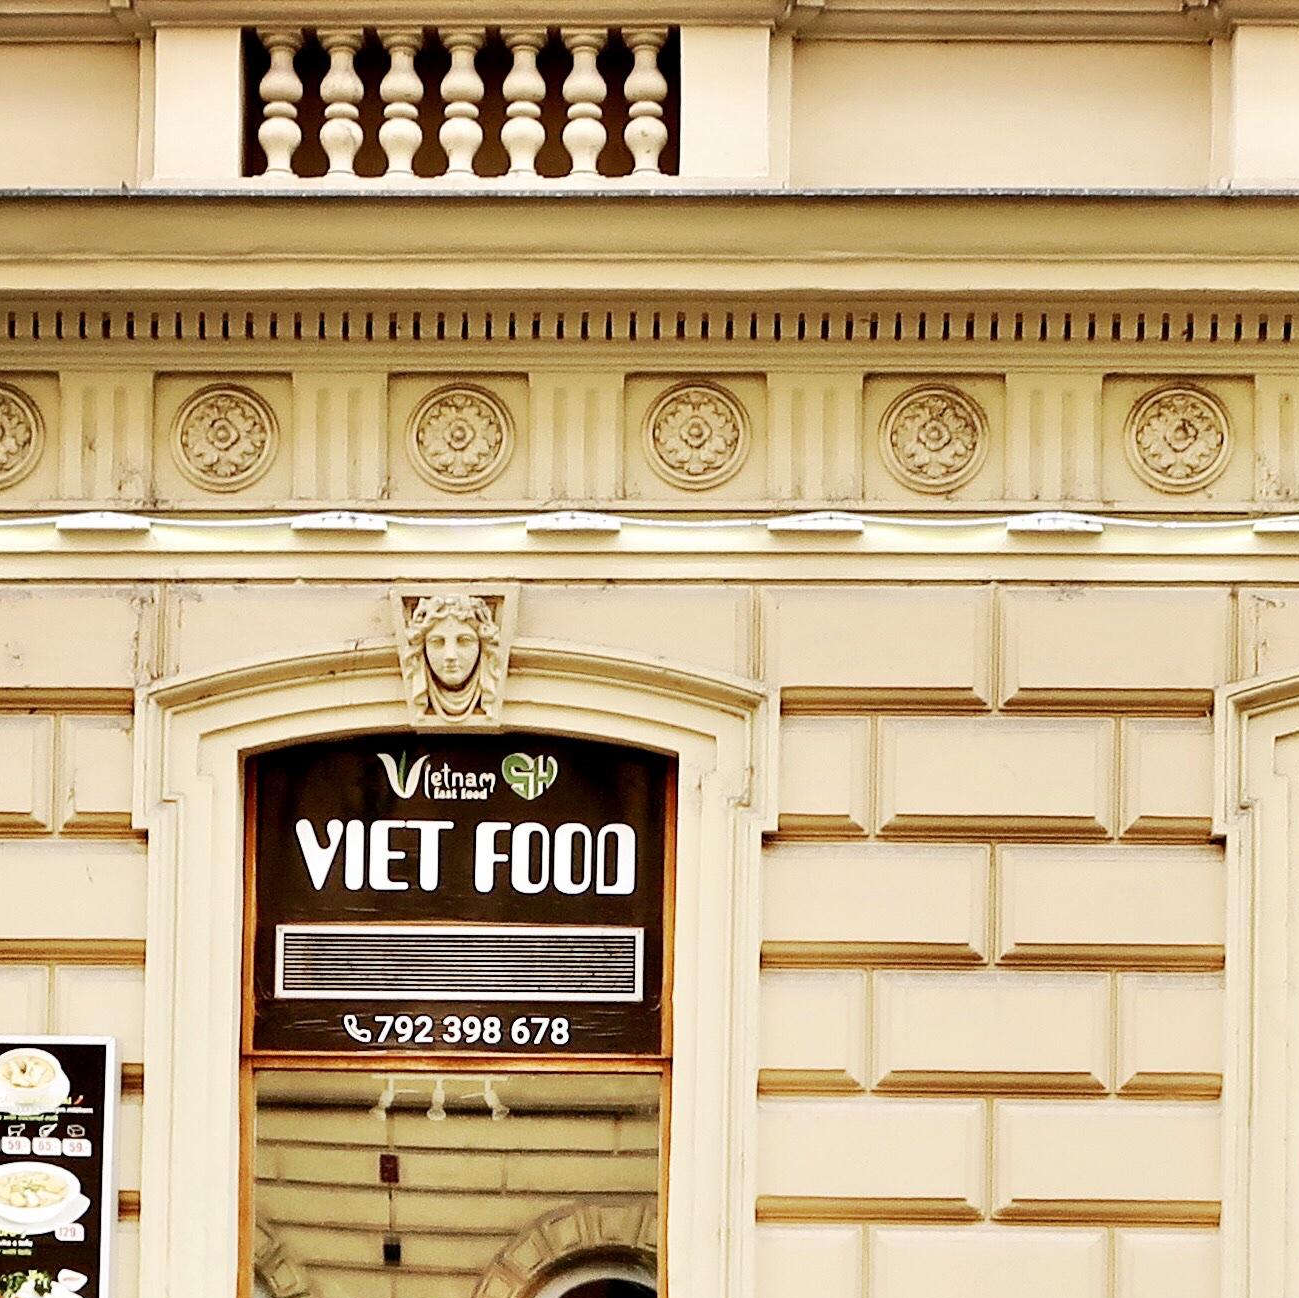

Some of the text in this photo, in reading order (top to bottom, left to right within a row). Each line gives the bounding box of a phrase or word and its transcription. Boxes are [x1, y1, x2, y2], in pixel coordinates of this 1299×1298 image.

[377, 750, 495, 798] Vietnam
[434, 786, 487, 799] fast food
[295, 819, 636, 895] VIET FOOD
[375, 1016, 569, 1045] 792 398 678
